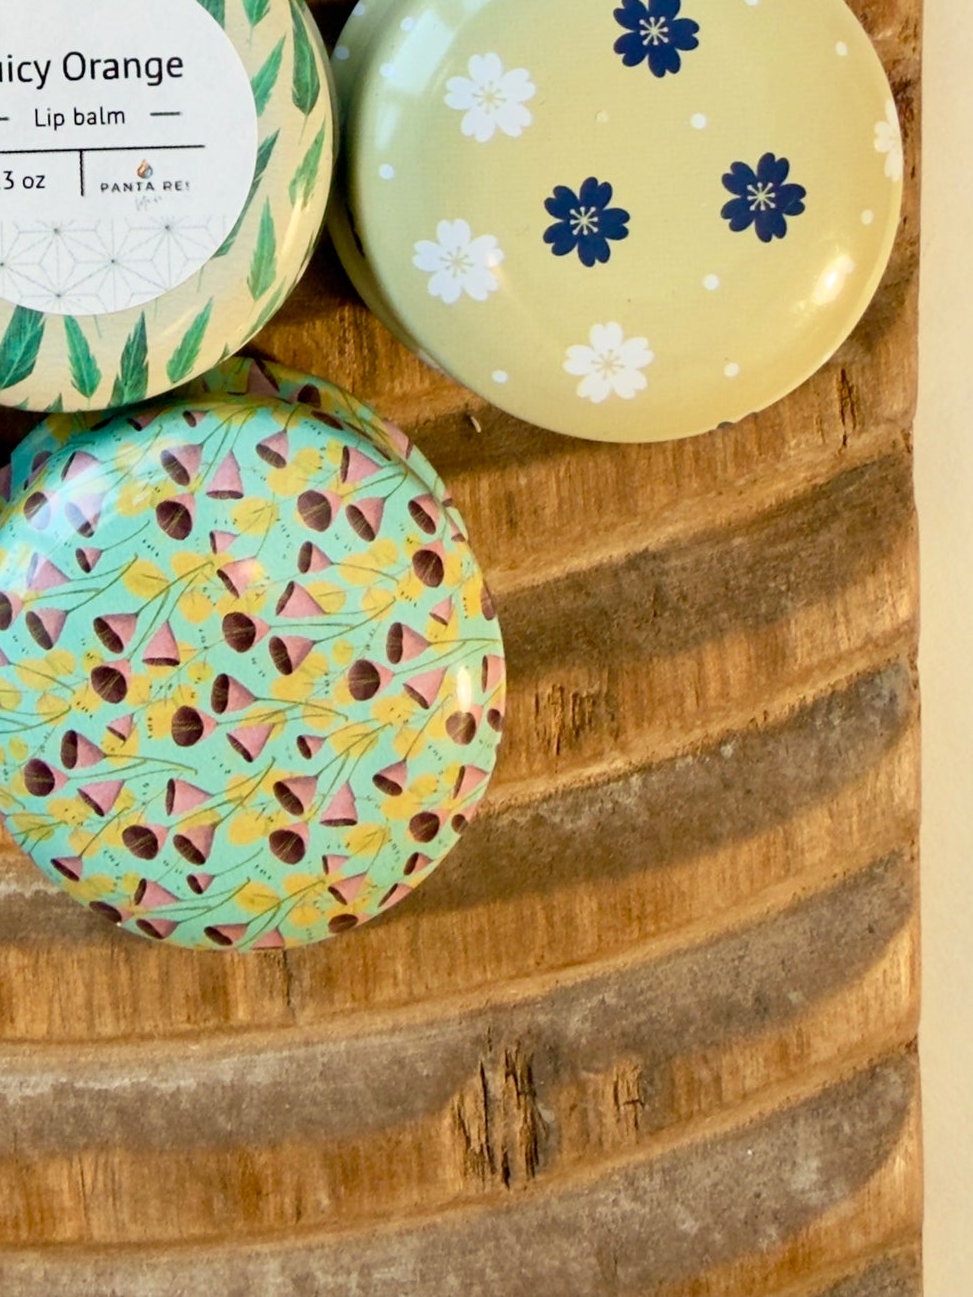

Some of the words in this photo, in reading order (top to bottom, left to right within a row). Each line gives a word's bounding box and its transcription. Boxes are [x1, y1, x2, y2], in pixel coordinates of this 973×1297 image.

[62, 51, 184, 87] Orange
[34, 108, 66, 131] Lip
[73, 106, 125, 126] balm
[22, 174, 46, 190] oz
[100, 182, 156, 193] PANTA
